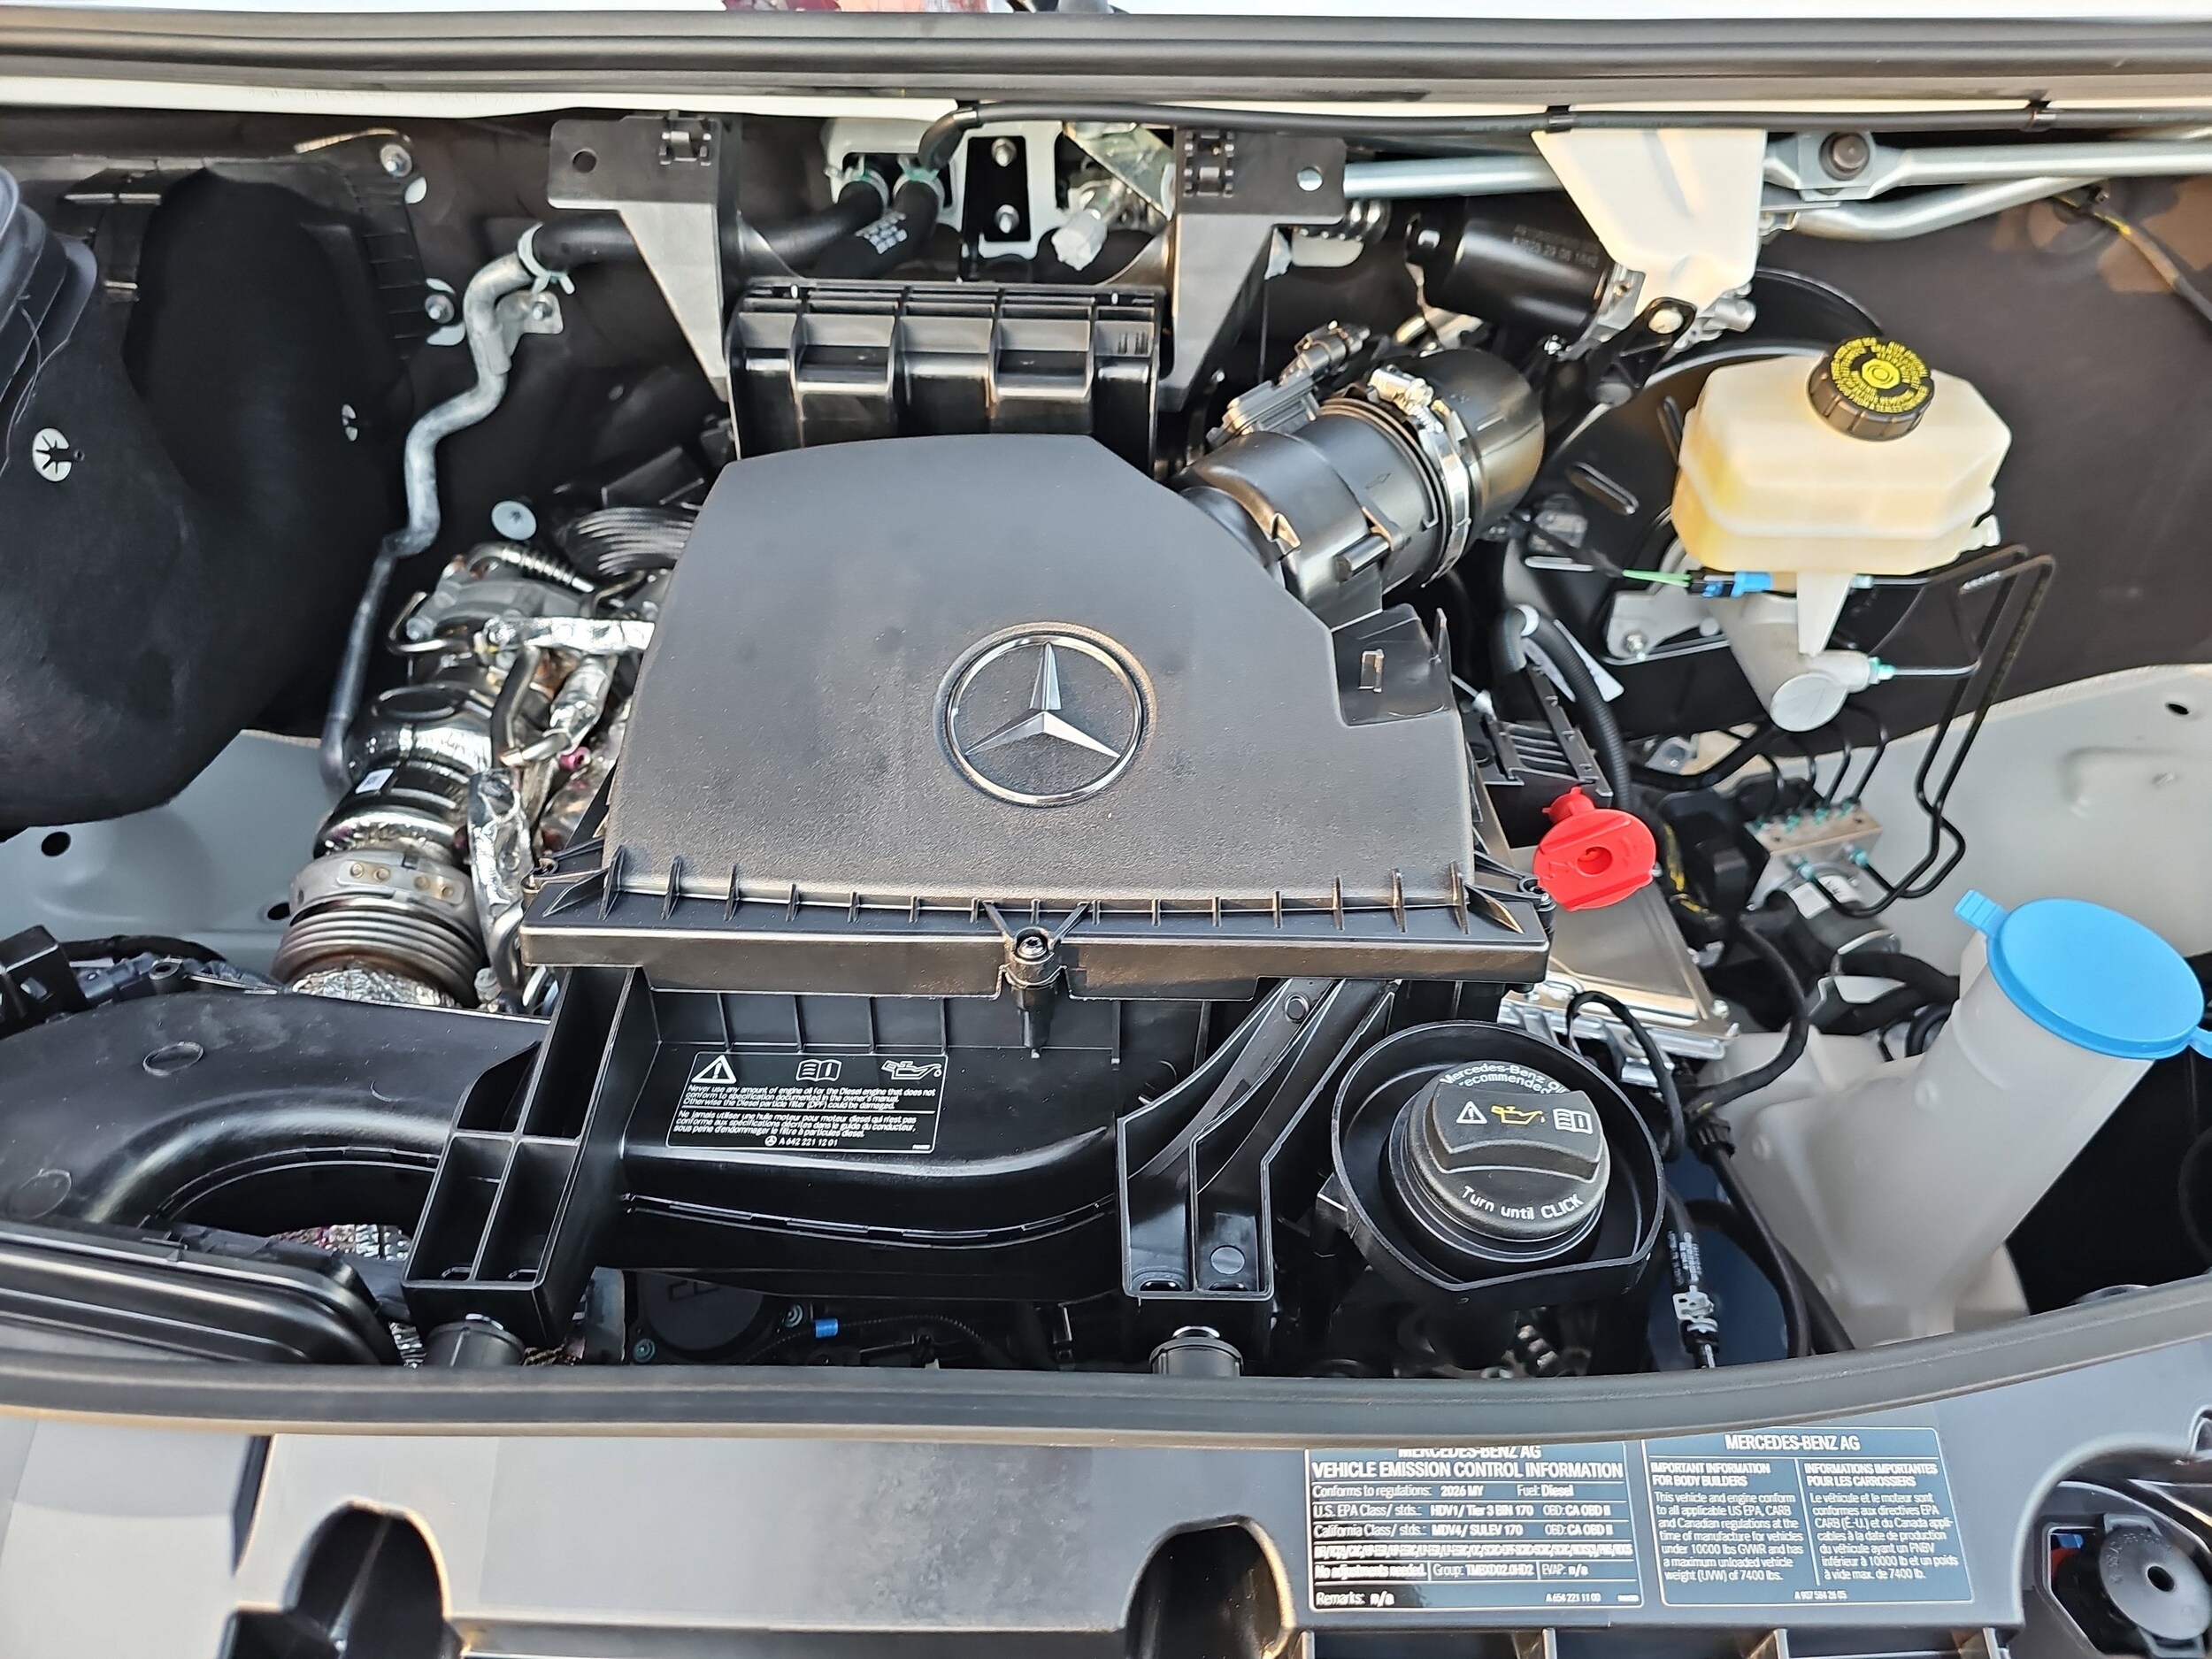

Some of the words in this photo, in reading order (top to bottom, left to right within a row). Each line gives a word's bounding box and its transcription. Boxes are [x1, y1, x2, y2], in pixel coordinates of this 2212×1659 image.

[1440, 1063, 1546, 1084] Mercedes-Benz
[687, 1084, 710, 1093] Never
[778, 1087, 803, 1096] engine
[862, 1088, 886, 1097] engine
[1462, 1186, 1494, 1212] Turn
[1501, 1206, 1534, 1220] until
[1540, 1194, 1585, 1219] CLICK
[1724, 1435, 1839, 1450] MERCEDES-BENZ
[1840, 1436, 1860, 1450] AG
[1398, 1446, 1518, 1458] MERCEDES-BENZ
[1520, 1445, 1541, 1458] AG
[1311, 1462, 1377, 1478] VEHICLE
[1379, 1462, 1451, 1477] EMISSION
[1454, 1462, 1524, 1478] CONTROL
[1525, 1462, 1624, 1478] INFORMATION
[1650, 1462, 1704, 1473] IMPORTANT
[1705, 1463, 1770, 1473] INFORMATION
[1804, 1463, 1874, 1474] INFORMATIONS
[1874, 1463, 1938, 1474] IMPORTANTES
[1652, 1475, 1672, 1486] FOR
[1673, 1475, 1700, 1486] BODY
[1701, 1476, 1747, 1486] BUILDERS
[1806, 1476, 1834, 1486] POUR
[1833, 1476, 1852, 1486] LES
[1853, 1476, 1916, 1486] CARROSSIERS
[1311, 1484, 1362, 1497] Conforms
[1376, 1484, 1432, 1499] regulations:
[1440, 1486, 1466, 1496] 2026
[1467, 1486, 1484, 1496] MY
[1517, 1485, 1540, 1496] Fuel:
[1541, 1485, 1574, 1496] Diesel
[1654, 1491, 1674, 1502] This
[1675, 1492, 1707, 1502] vehicle
[1709, 1493, 1726, 1502] and
[1727, 1493, 1757, 1504] engine
[1758, 1493, 1795, 1502] conform
[1313, 1503, 1336, 1517] U.S.
[1681, 1505, 1727, 1517] applicable
[1727, 1505, 1742, 1516] US
[1743, 1505, 1764, 1517] EPA,
[1765, 1505, 1792, 1516] CARB
[1658, 1517, 1676, 1528] and
[1677, 1517, 1720, 1528] Canadian
[1721, 1517, 1770, 1530] regulations
[1782, 1518, 1799, 1528] the
[1314, 1524, 1363, 1538] California
[1470, 1525, 1502, 1536] SULEV
[1504, 1525, 1523, 1535] 170
[1567, 1524, 1582, 1535] CA
[1583, 1524, 1605, 1535] OBD
[1659, 1530, 1681, 1540] time
[1694, 1530, 1751, 1541] manufacture
[1766, 1531, 1803, 1540] vehicles
[1661, 1543, 1687, 1554] under
[1691, 1544, 1721, 1554] 10000
[1722, 1544, 1736, 1555] lbs
[1768, 1544, 1786, 1554] and
[1786, 1544, 1803, 1554] has
[1671, 1556, 1717, 1567] maximum
[1717, 1557, 1760, 1567] unloaded
[1760, 1556, 1793, 1567] vehicle
[1568, 1563, 1588, 1577] n/a
[1664, 1570, 1696, 1583] weight
[1740, 1570, 1764, 1580] 7400
[1765, 1570, 1783, 1580] lbs.
[1316, 1591, 1365, 1605] Remarks:
[1370, 1591, 1394, 1605] n/a
